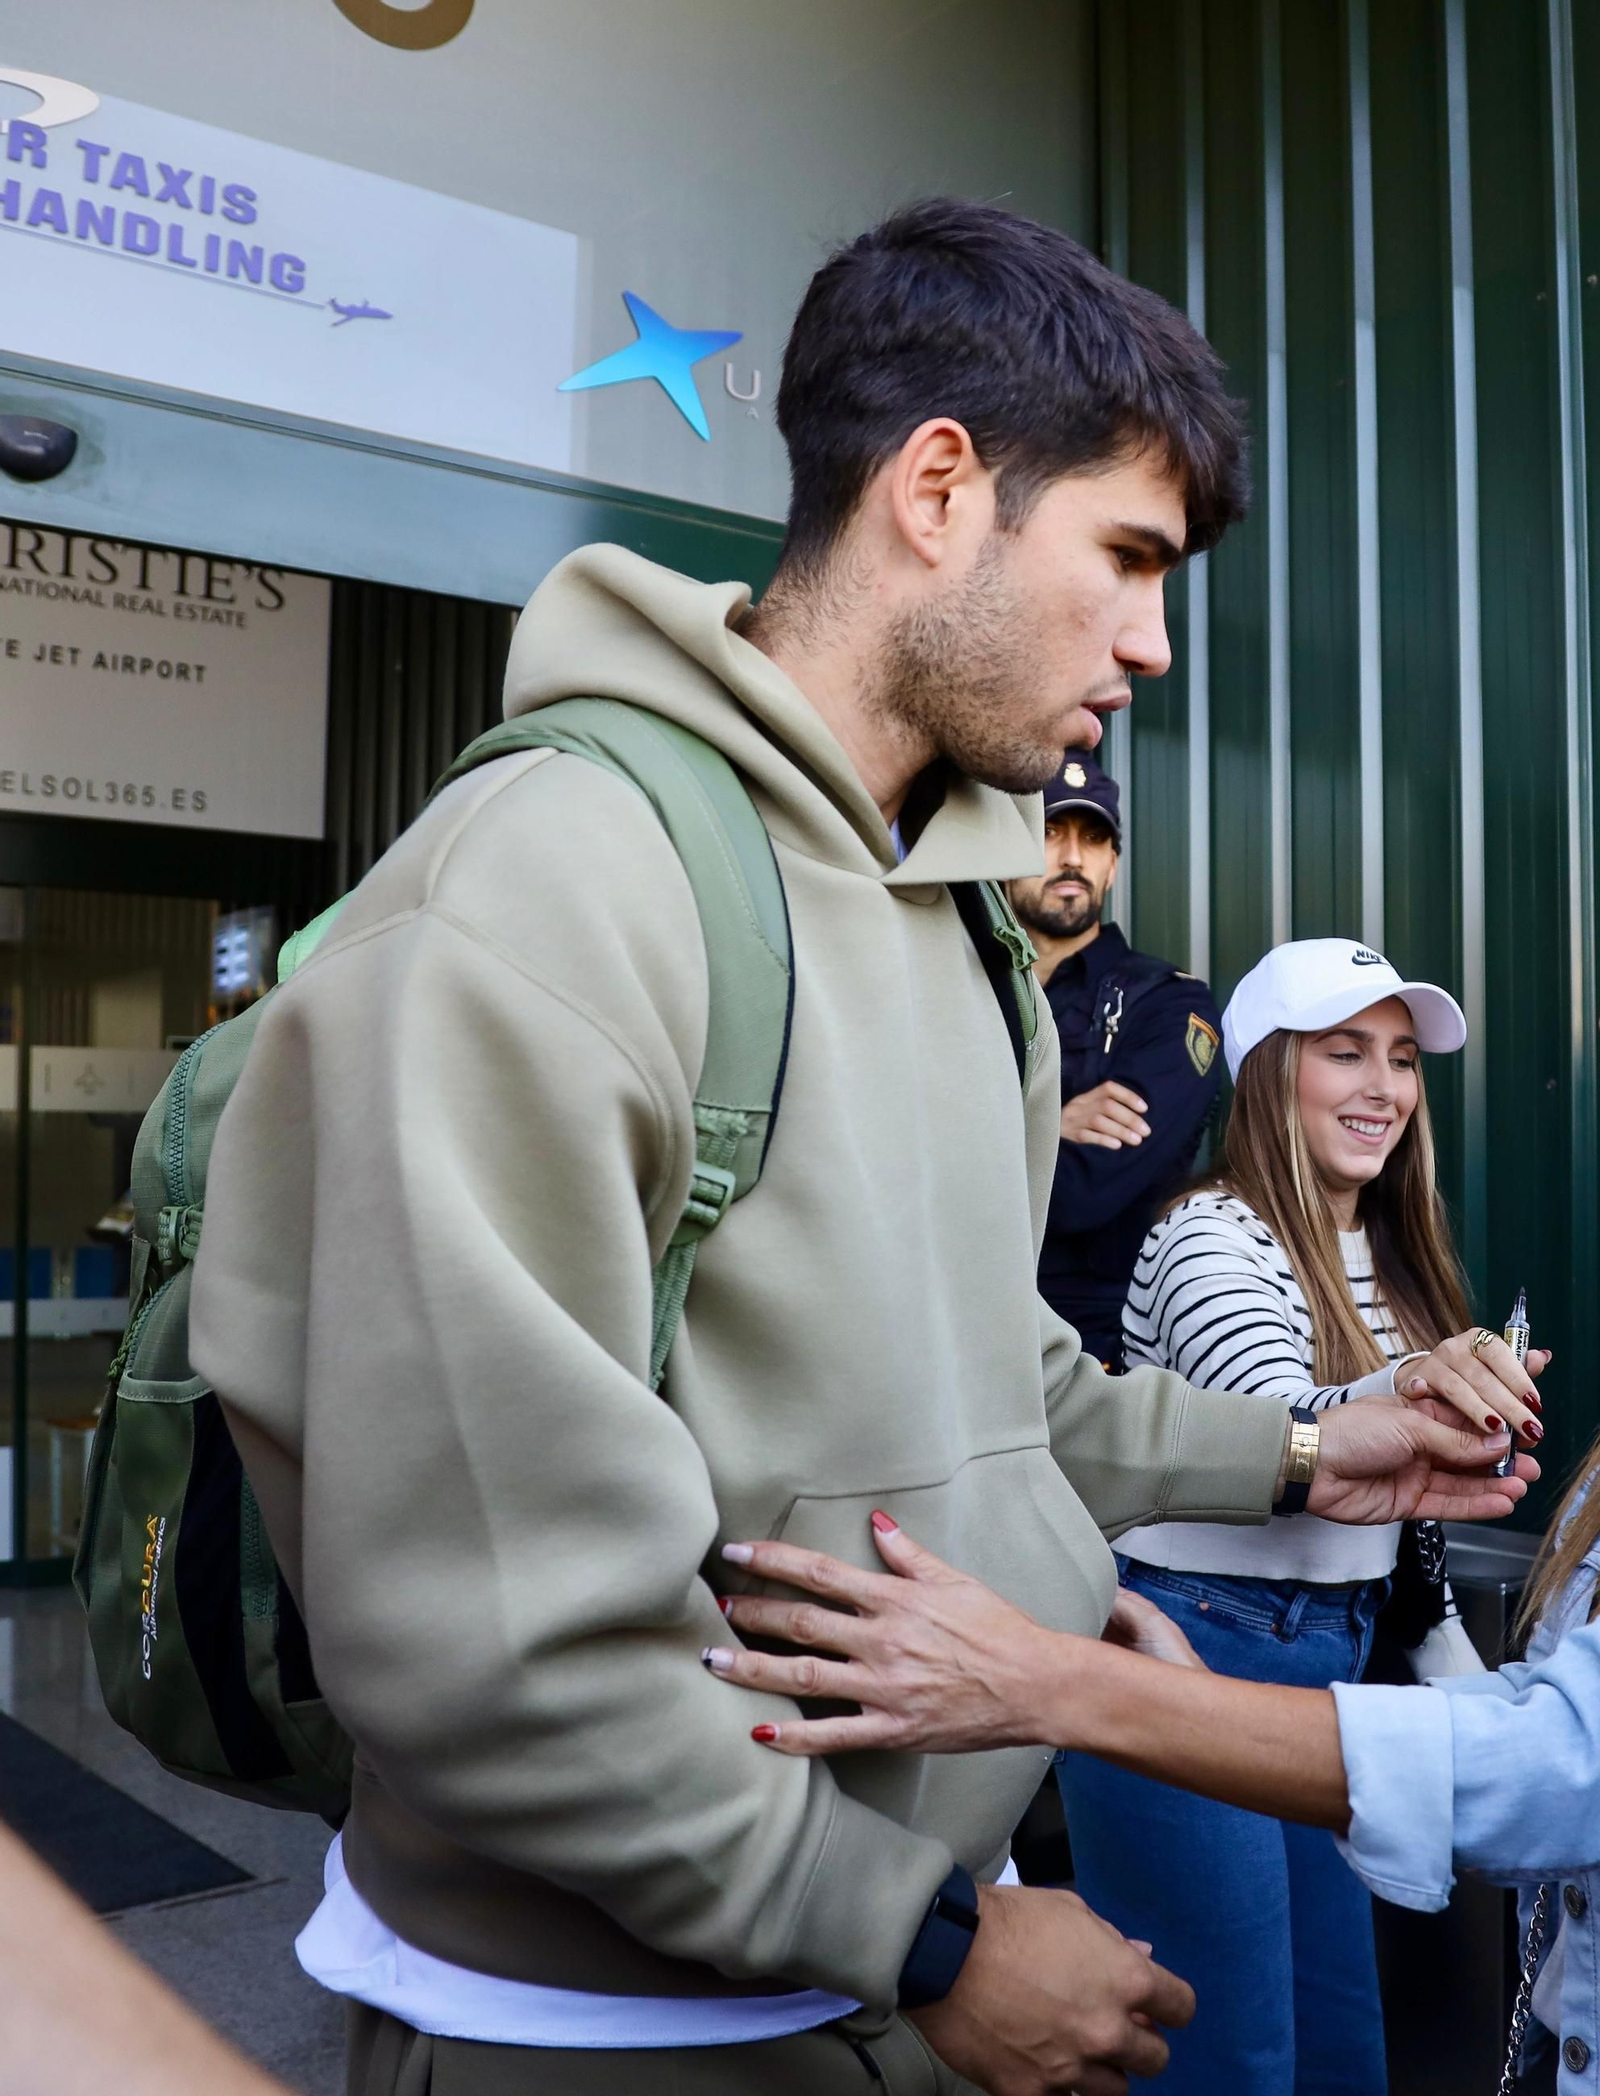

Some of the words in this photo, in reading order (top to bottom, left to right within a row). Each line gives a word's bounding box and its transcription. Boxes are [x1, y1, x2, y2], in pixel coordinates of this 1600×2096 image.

[7, 119, 47, 169] R
[76, 138, 258, 225] TAXIS
[0, 178, 306, 293] HANDLING
[112, 591, 167, 618] REAL
[173, 602, 248, 629] ESTATE
[33, 643, 81, 667] JET
[92, 651, 208, 683] AIRPORT
[0, 770, 208, 813] ELSOL365.ES
[141, 1516, 158, 1680] CORDURA
